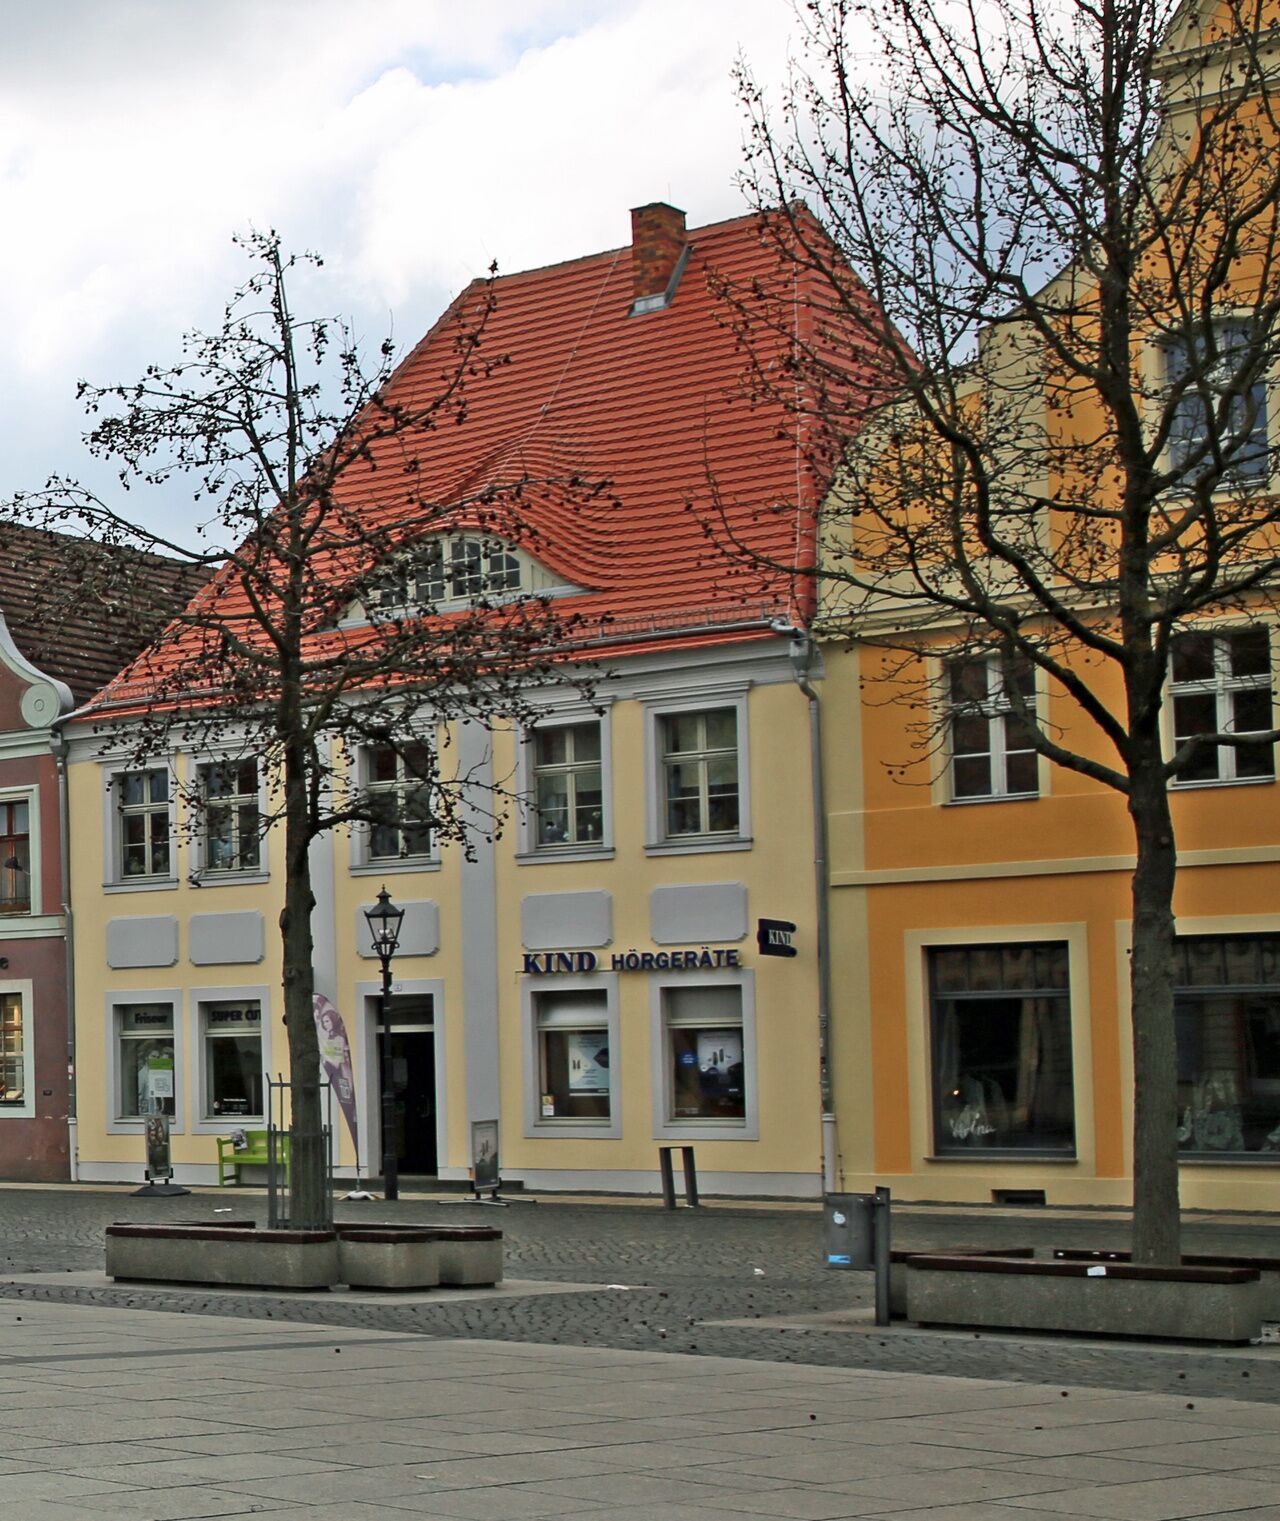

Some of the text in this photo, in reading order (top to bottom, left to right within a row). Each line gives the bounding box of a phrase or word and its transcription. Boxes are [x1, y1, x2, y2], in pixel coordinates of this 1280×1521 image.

[768, 929, 791, 946] KIND
[522, 946, 740, 974] KIND HÖRGERÄTE
